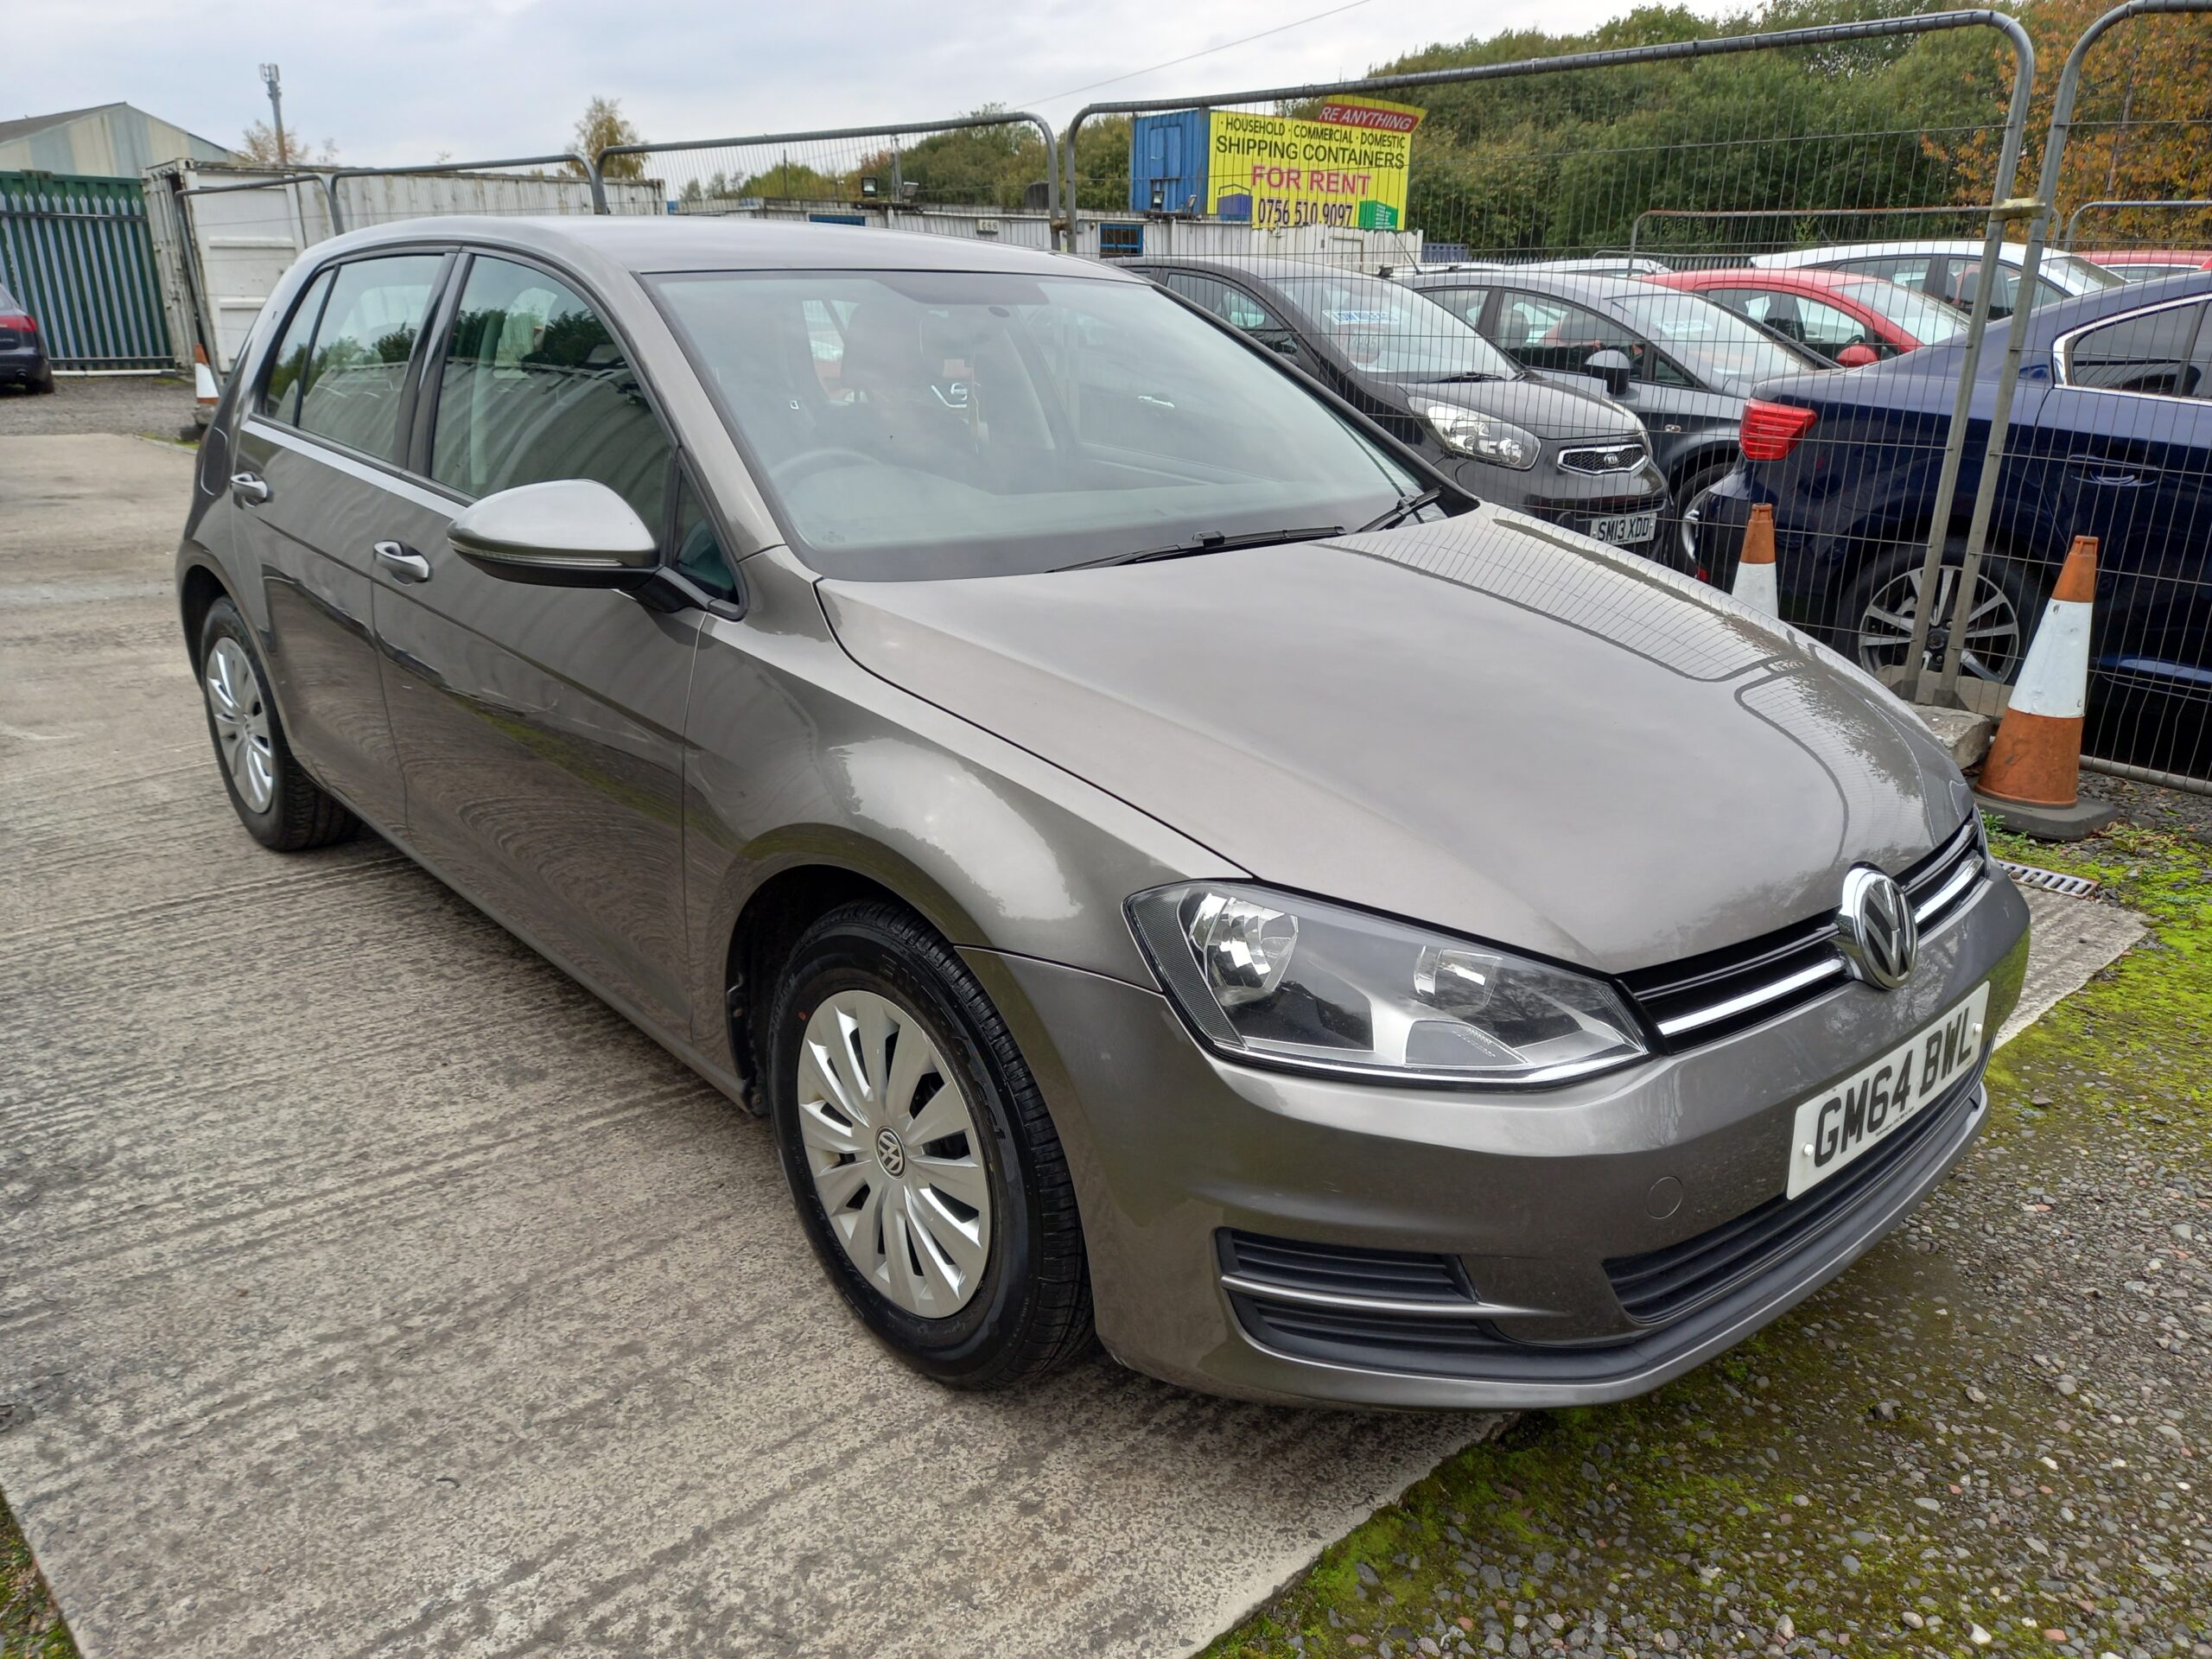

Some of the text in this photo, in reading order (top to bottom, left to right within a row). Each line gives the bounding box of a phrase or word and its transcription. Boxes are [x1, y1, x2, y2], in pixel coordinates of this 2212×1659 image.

[1225, 118, 1406, 149] HOUSEHOLD COMMERCIAL DOMESTIC
[1340, 109, 1412, 130] ANYTHING
[1217, 135, 1405, 169] SHIPPING CONTAINERS
[1252, 165, 1371, 196] FOR RENT
[1598, 520, 1626, 542] SM13
[1814, 1007, 1973, 1168] GM64 BWL
